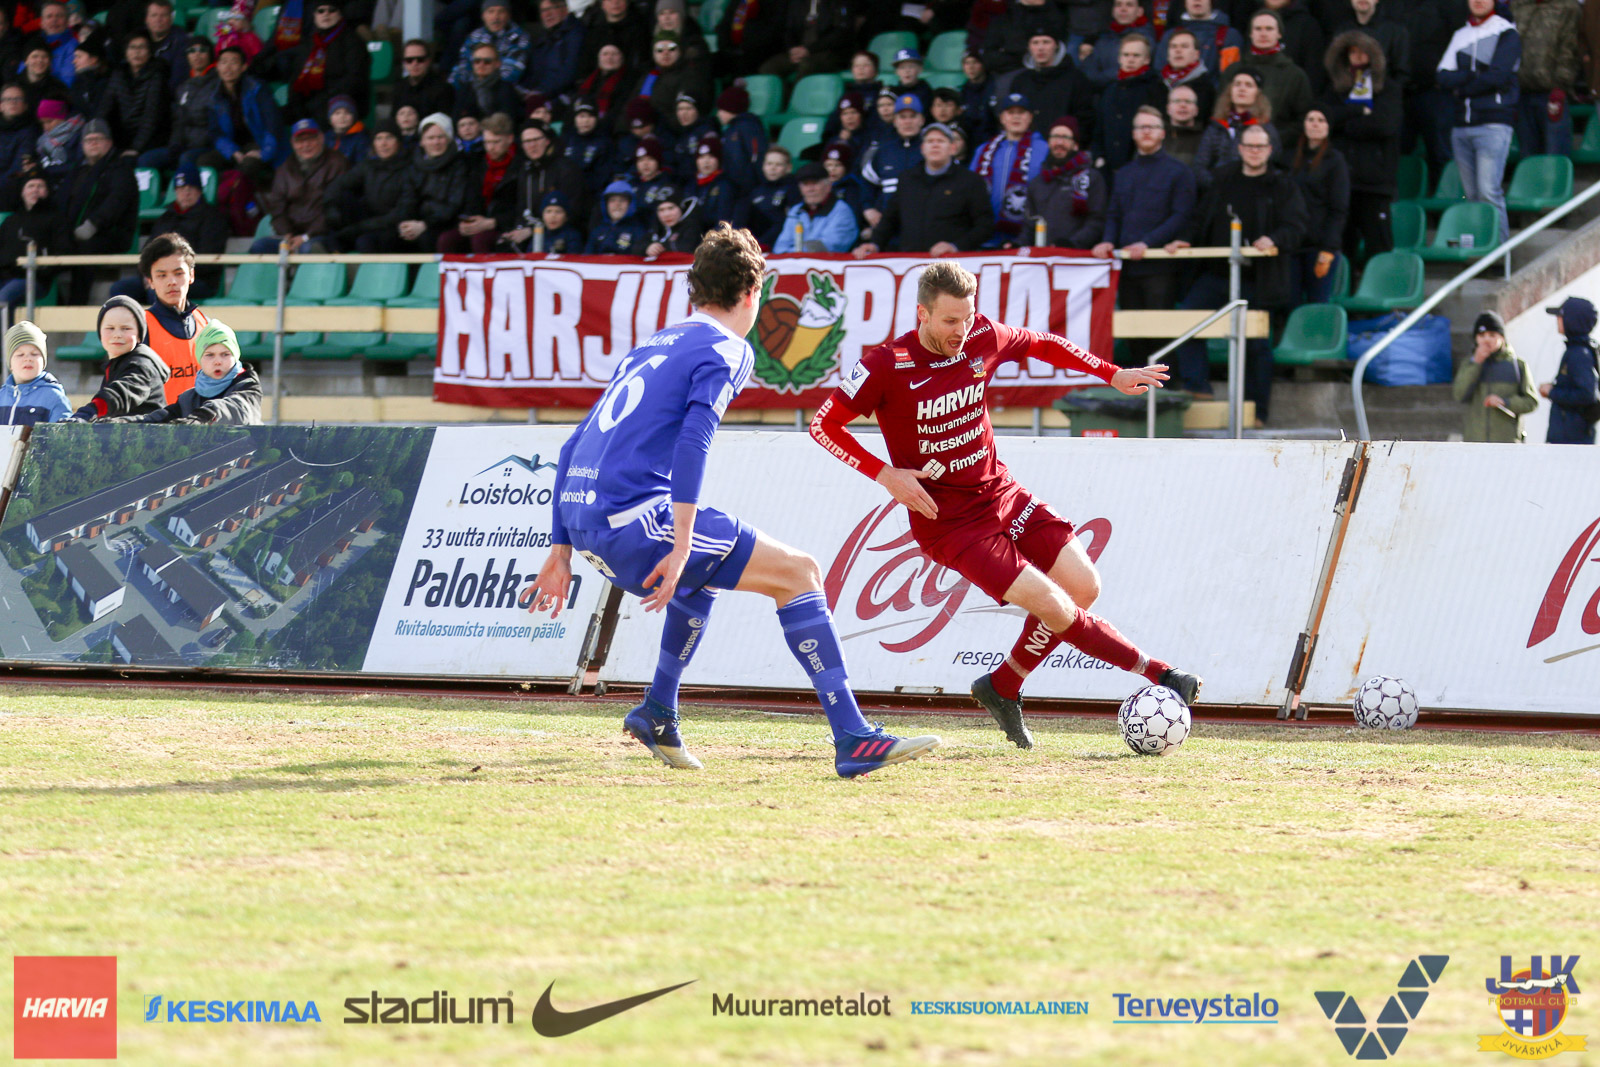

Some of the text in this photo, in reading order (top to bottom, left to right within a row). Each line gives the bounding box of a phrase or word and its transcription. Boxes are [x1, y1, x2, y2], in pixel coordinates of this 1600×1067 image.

[441, 263, 1110, 381] HARJU PAT
[929, 351, 967, 369] stadium
[583, 354, 669, 433] 16
[916, 380, 985, 420] HARVIA
[930, 423, 985, 453] KESKIMAA
[949, 446, 989, 473] Fimpec
[459, 482, 554, 506] Loistoko
[422, 526, 553, 549] 33 uutta rivitaloas
[403, 557, 582, 610] Palokkan
[394, 619, 566, 642] Rivitaloasumista vimosen päälle
[952, 650, 1007, 672] resep
